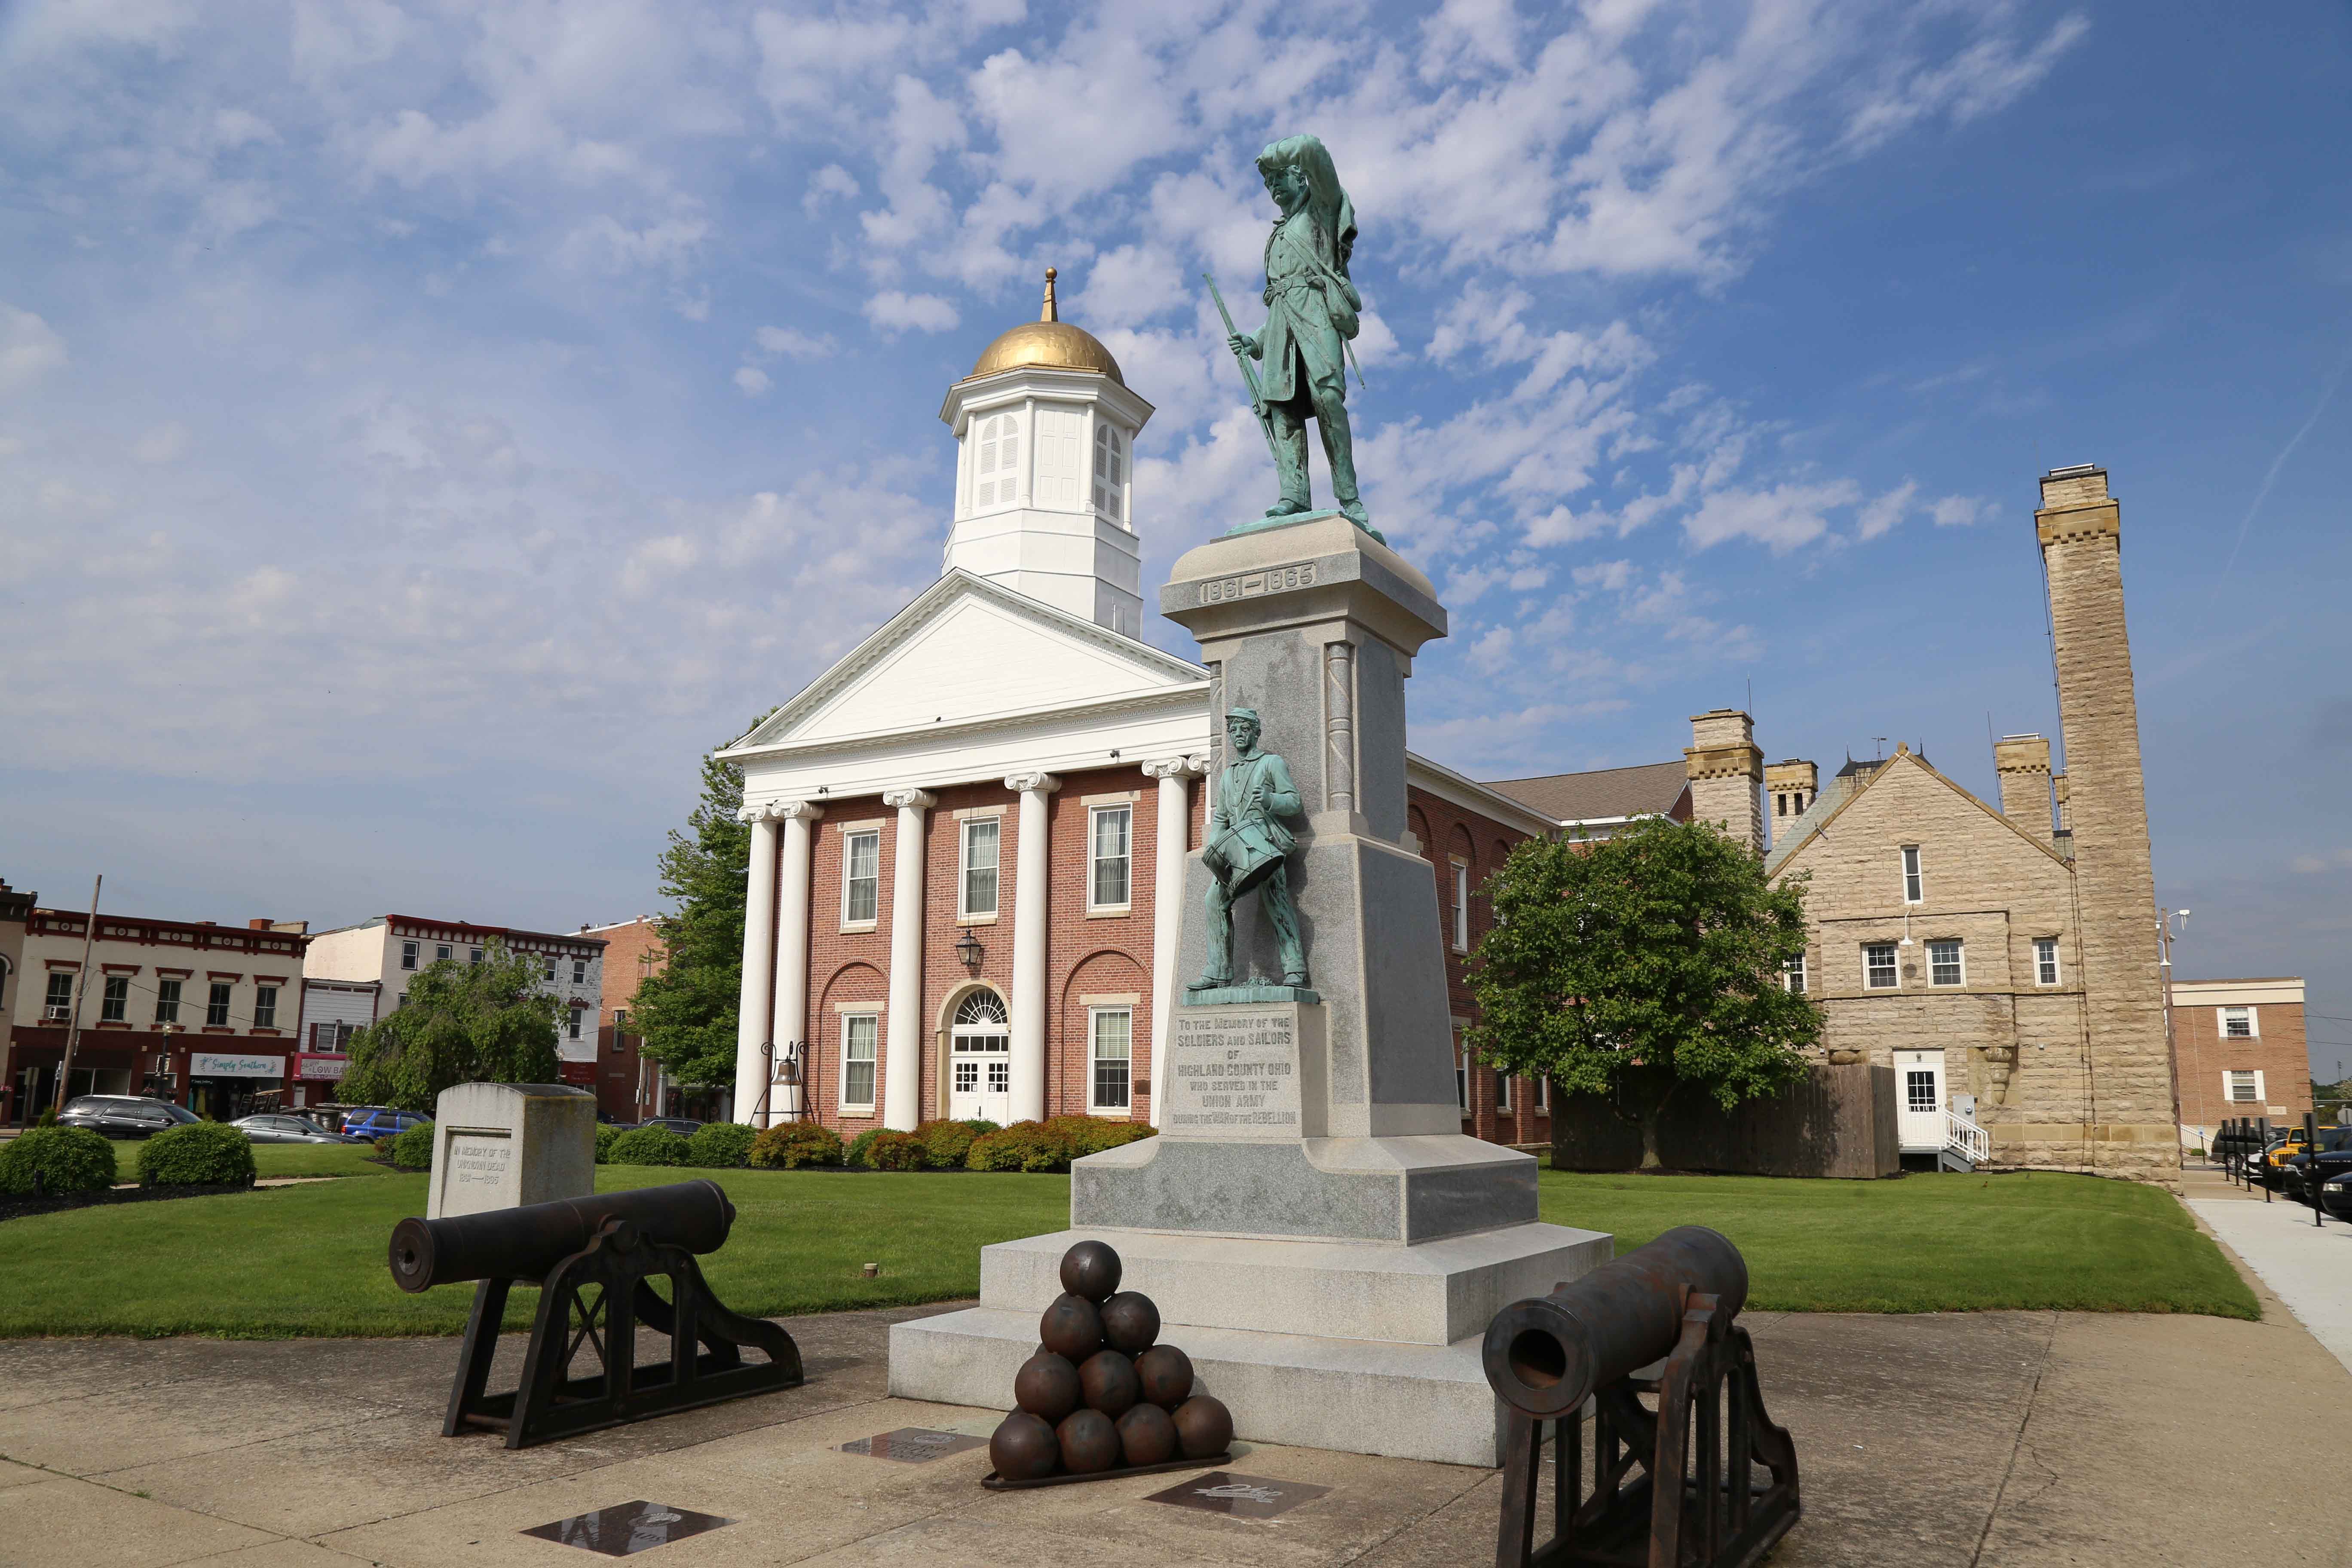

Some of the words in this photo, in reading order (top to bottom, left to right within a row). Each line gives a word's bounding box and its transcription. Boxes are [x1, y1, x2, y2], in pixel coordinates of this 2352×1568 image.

[1193, 1020, 1211, 1030] THE
[1214, 1018, 1254, 1029] MEMORY
[1256, 1018, 1268, 1028] OF
[1271, 1018, 1289, 1027] THE
[1178, 1034, 1224, 1047] SOLDIERS
[1227, 1036, 1245, 1046] AND
[1248, 1032, 1291, 1045] SAILORS
[1227, 1050, 1239, 1060] OF
[212, 1059, 236, 1072] Simply
[238, 1059, 266, 1070] Southern
[1178, 1064, 1224, 1077] HIGHLAND
[1227, 1063, 1265, 1076] COUNTY
[1268, 1063, 1290, 1075] OHIO
[1190, 1081, 1208, 1091] WHO
[1211, 1081, 1245, 1091] SERVED
[1248, 1081, 1257, 1090] IN
[1260, 1081, 1278, 1090] THE
[1202, 1095, 1231, 1108] UNION
[1236, 1095, 1265, 1107] ARMY
[1173, 1114, 1198, 1124] DURING
[1199, 1114, 1212, 1124] THE
[1212, 1112, 1229, 1124] WAR
[1229, 1114, 1239, 1124] OF
[1239, 1114, 1252, 1124] THE
[1253, 1111, 1296, 1124] REBELLION
[454, 1145, 461, 1155] IN
[462, 1147, 487, 1157] MEMORY
[489, 1148, 498, 1157] OF
[499, 1148, 511, 1158] THE
[457, 1159, 486, 1170] UNKNOWN
[487, 1161, 505, 1172] DEAD
